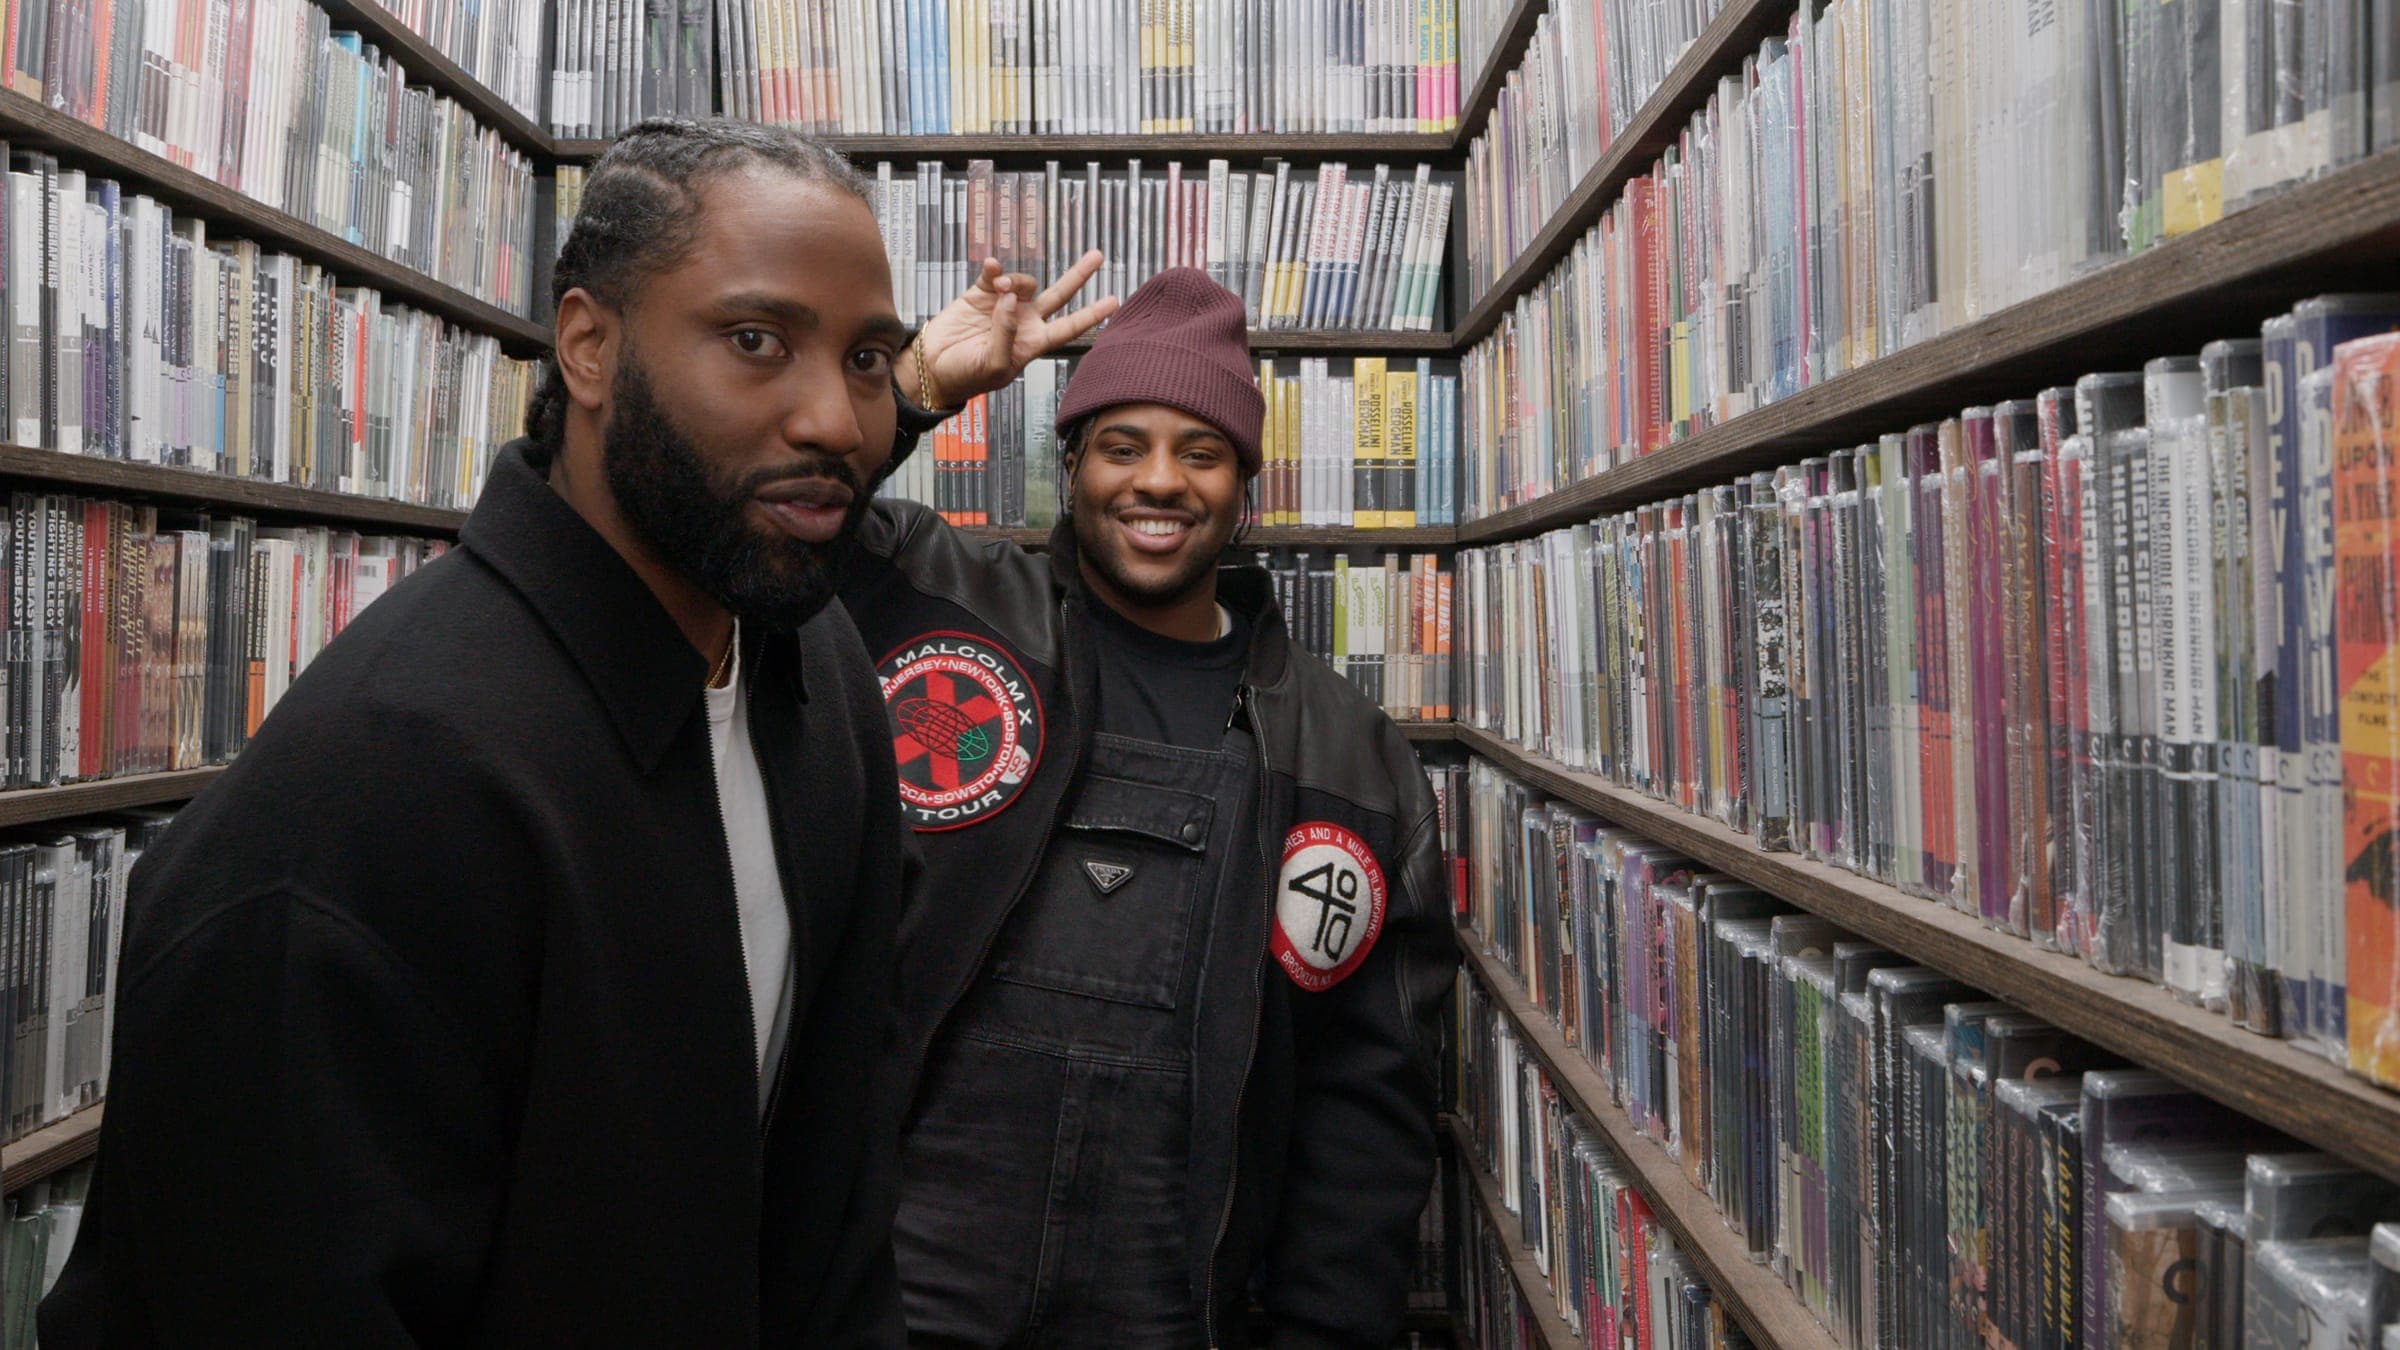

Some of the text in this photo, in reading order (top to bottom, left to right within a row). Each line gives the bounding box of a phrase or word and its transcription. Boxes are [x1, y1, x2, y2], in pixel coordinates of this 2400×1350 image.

[48, 175, 57, 288] THE PORNOGRAPHERS
[879, 180, 888, 219] PURPLE
[892, 185, 900, 256] PURPLE NOON
[905, 185, 913, 256] PURPLE NOON
[260, 292, 268, 364] IKIRU
[1032, 399, 1046, 442] SHOAH
[1359, 400, 1369, 448] BERGMAN
[1370, 394, 1380, 448] ROSSELLINI
[1390, 408, 1400, 455] BERGMAN
[1402, 401, 1412, 456] ROSSELLINI
[2078, 400, 2099, 606] HIGH SIERRA
[2157, 455, 2171, 485] THE
[2232, 419, 2249, 558] UNCUT GEMS
[2265, 360, 2287, 646] DEVI
[14, 508, 24, 628] YOUTH BEAST
[26, 509, 36, 627] YOUTH BEAST
[46, 509, 56, 627] FIGHTING ELEGY
[57, 510, 66, 626] FIGHTING ELEGY
[66, 521, 74, 563] CASQUE
[2111, 464, 2133, 674] HIGH SIERRA
[2131, 457, 2153, 673] HIGH SIERRA
[2158, 491, 2174, 590] INCREDIBLE
[2213, 499, 2228, 559] GEMS
[106, 578, 114, 646] HIGHWAY
[120, 520, 132, 633] NIGHT CITY
[127, 545, 137, 658] NIGHT CITY
[135, 545, 146, 657] NIGHT CITY
[1424, 564, 1435, 623] JUDEX
[1439, 582, 1449, 645] JUDEX
[2161, 595, 2176, 692] SHRINKING
[2187, 590, 2203, 689] SHRINKING
[895, 643, 1033, 726] MALCOLM X
[2163, 697, 2177, 737] MAN
[2190, 696, 2204, 735] MAN
[996, 709, 1016, 771] BOSTON
[1008, 755, 1030, 778] 92
[916, 789, 1003, 821] TOUR
[933, 773, 995, 803] SOWETO
[1310, 828, 1383, 940] AND A MULE FILMWORKS
[1280, 950, 1318, 986] BROOKLYN
[1966, 1096, 1978, 1264] EXOTICA
[1995, 1115, 2007, 1314] SOUND OF METAL
[2083, 1159, 2096, 1242] ARSENIC
[2009, 1125, 2020, 1326] SOUND OF METAL
[2024, 1136, 2037, 1340] SOUND OF METAL
[2058, 1145, 2072, 1344] LOST HIGHWAY
[2042, 1209, 2052, 1329] HIGHWAY
